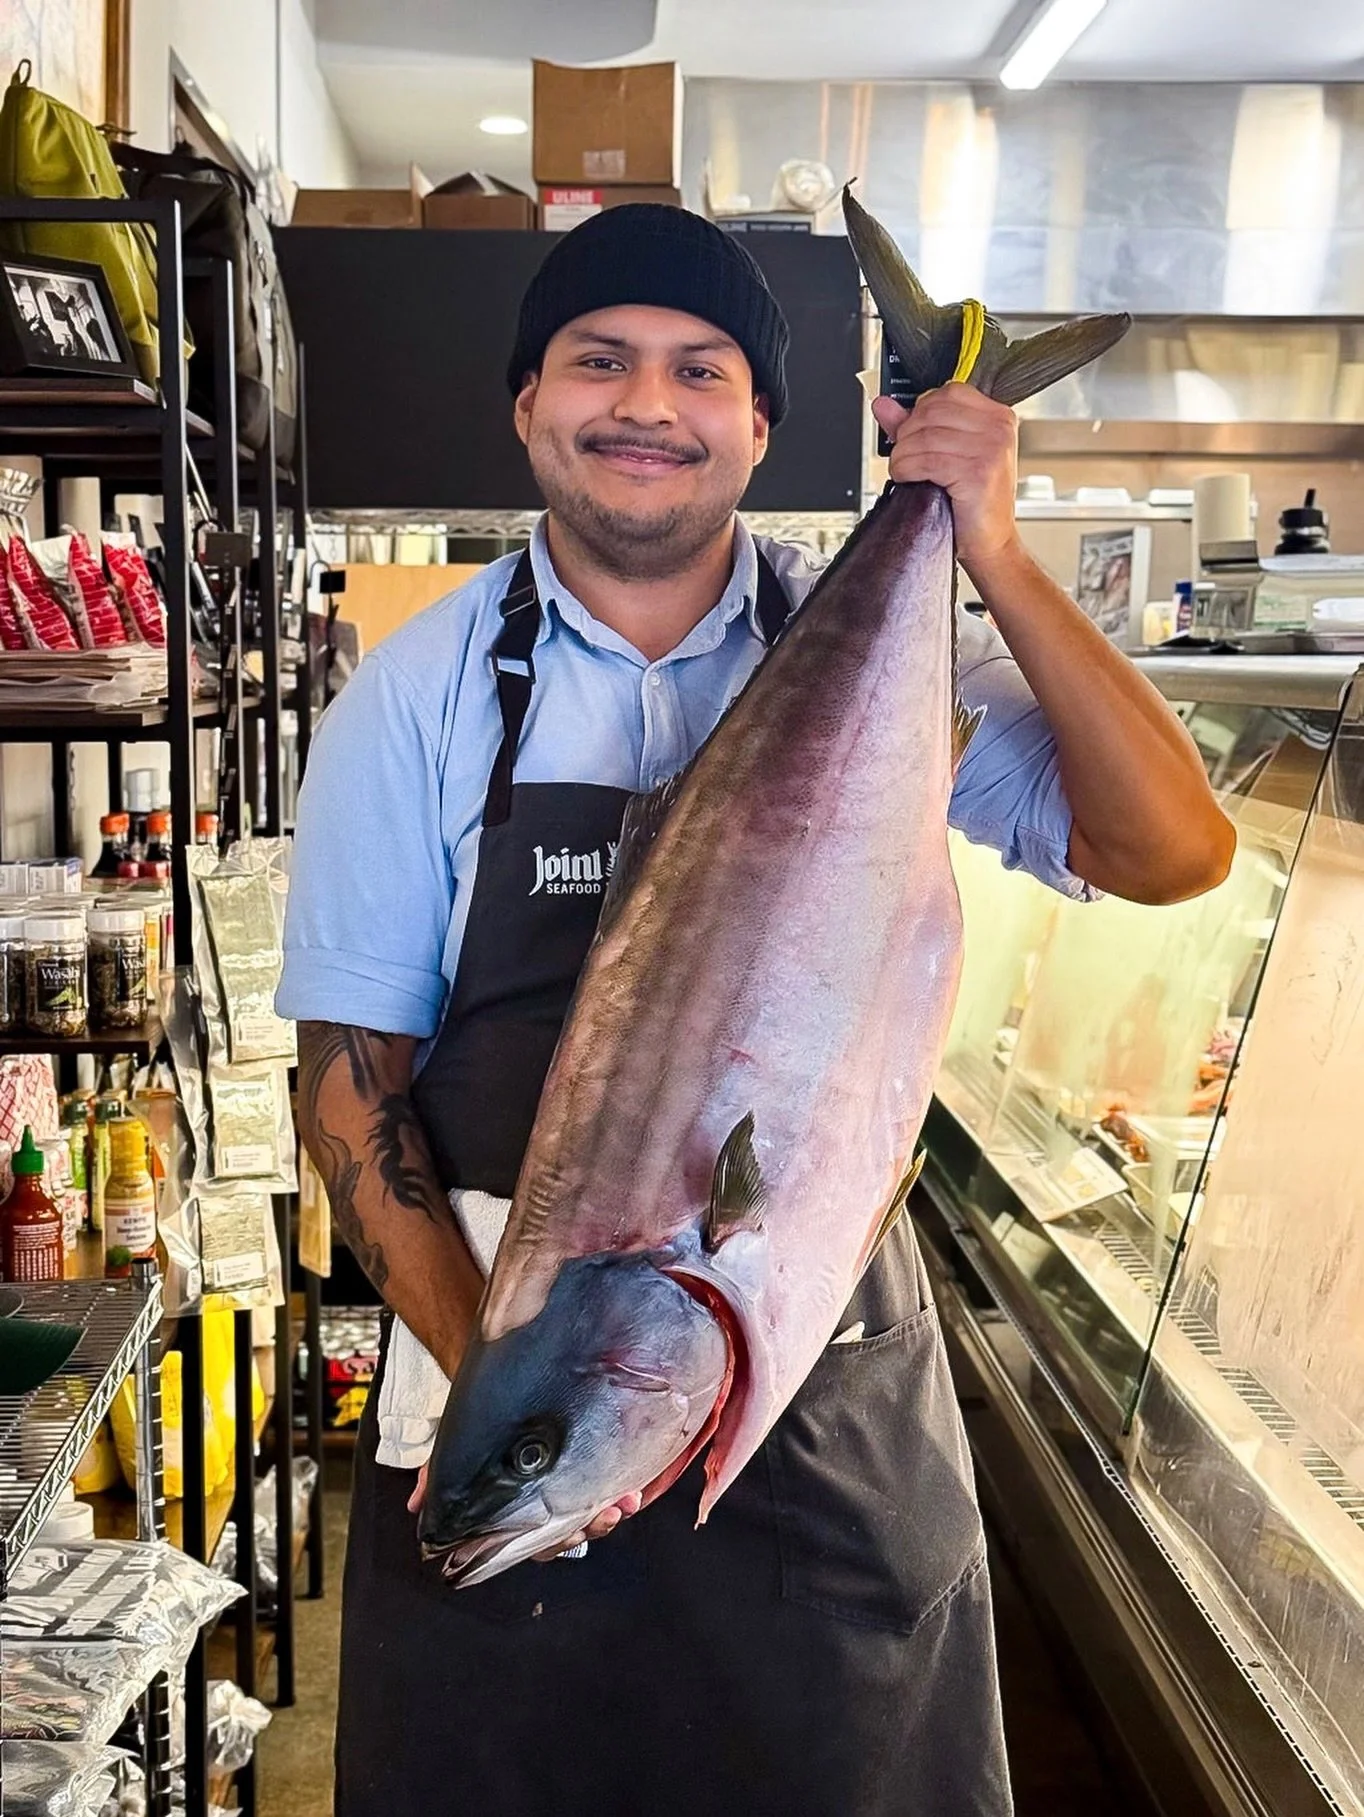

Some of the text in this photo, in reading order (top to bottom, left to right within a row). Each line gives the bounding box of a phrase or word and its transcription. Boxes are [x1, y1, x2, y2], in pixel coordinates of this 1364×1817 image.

[552, 190, 594, 204] ULINE
[529, 845, 603, 896] Joint
[546, 882, 602, 895] SEAFOOD
[41, 965, 81, 980] Wasabi
